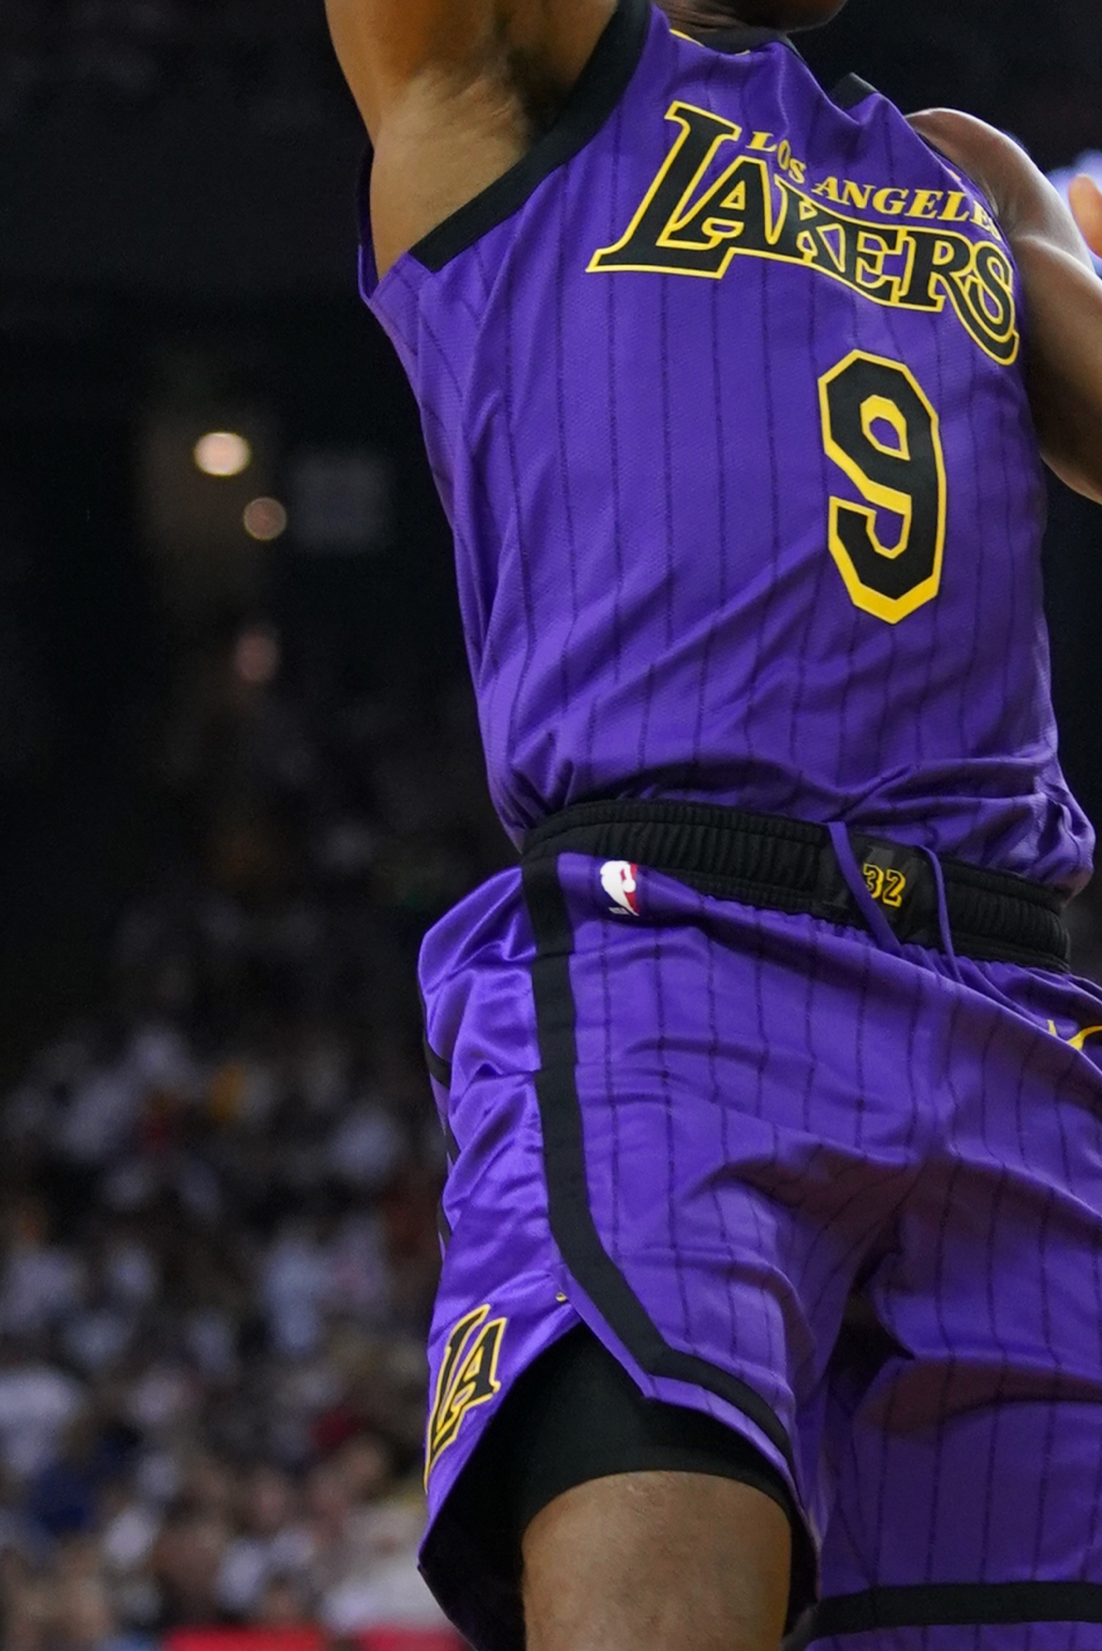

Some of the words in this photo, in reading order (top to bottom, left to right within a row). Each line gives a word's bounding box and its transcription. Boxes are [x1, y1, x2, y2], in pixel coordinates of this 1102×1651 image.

[586, 100, 1019, 365] LAKERS
[745, 131, 806, 184] LOS
[818, 349, 947, 624] 9
[862, 863, 907, 908] 32
